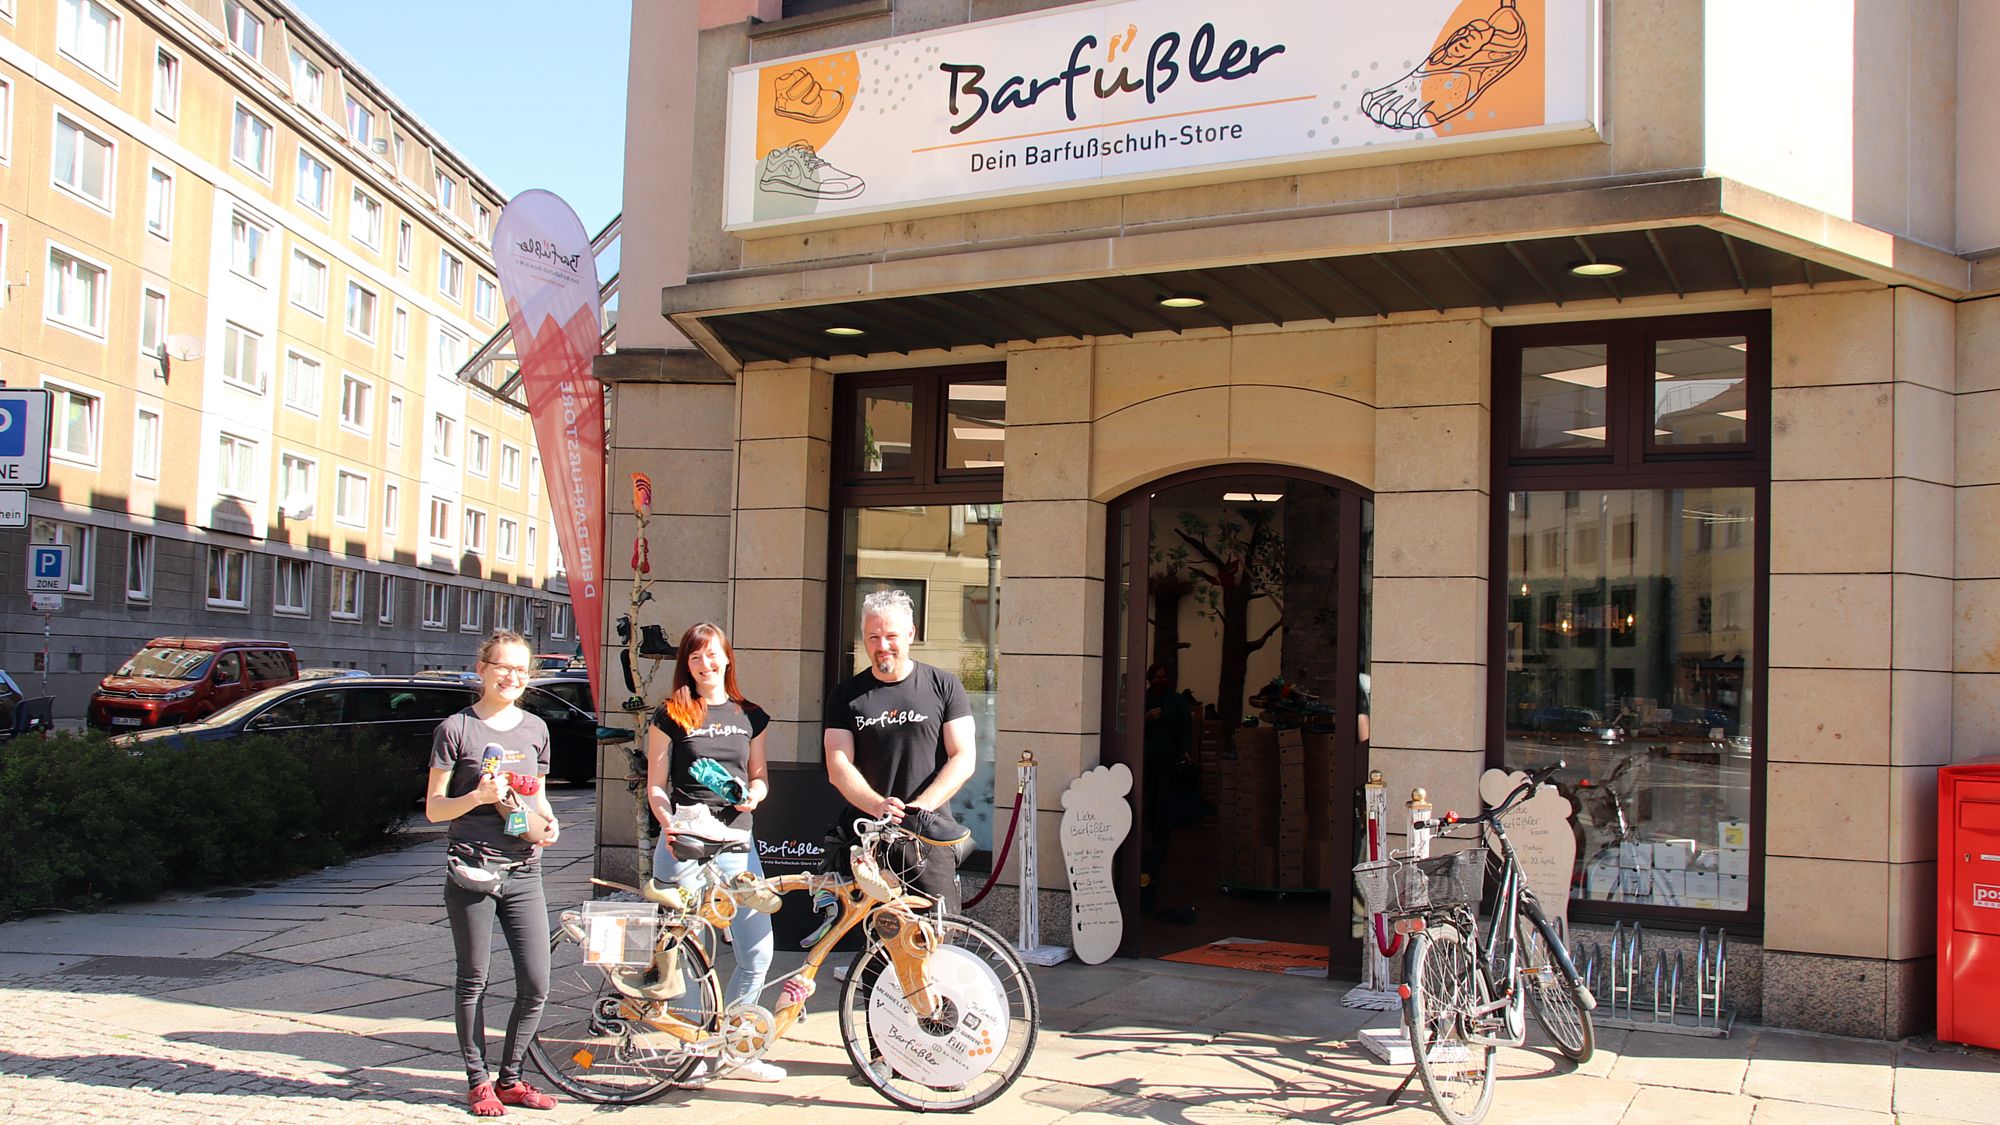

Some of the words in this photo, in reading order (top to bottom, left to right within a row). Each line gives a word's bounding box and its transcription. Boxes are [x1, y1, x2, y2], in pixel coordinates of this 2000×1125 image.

[940, 22, 1286, 134] Barfüßler
[971, 150, 1017, 173] Dein
[1025, 123, 1243, 167] Barfußschuh-Store
[42, 553, 56, 573] P
[36, 580, 59, 588] ZONE
[855, 709, 928, 730] Barfüßler
[758, 840, 821, 857] Barfüßle
[888, 1023, 940, 1066] Barfüßler
